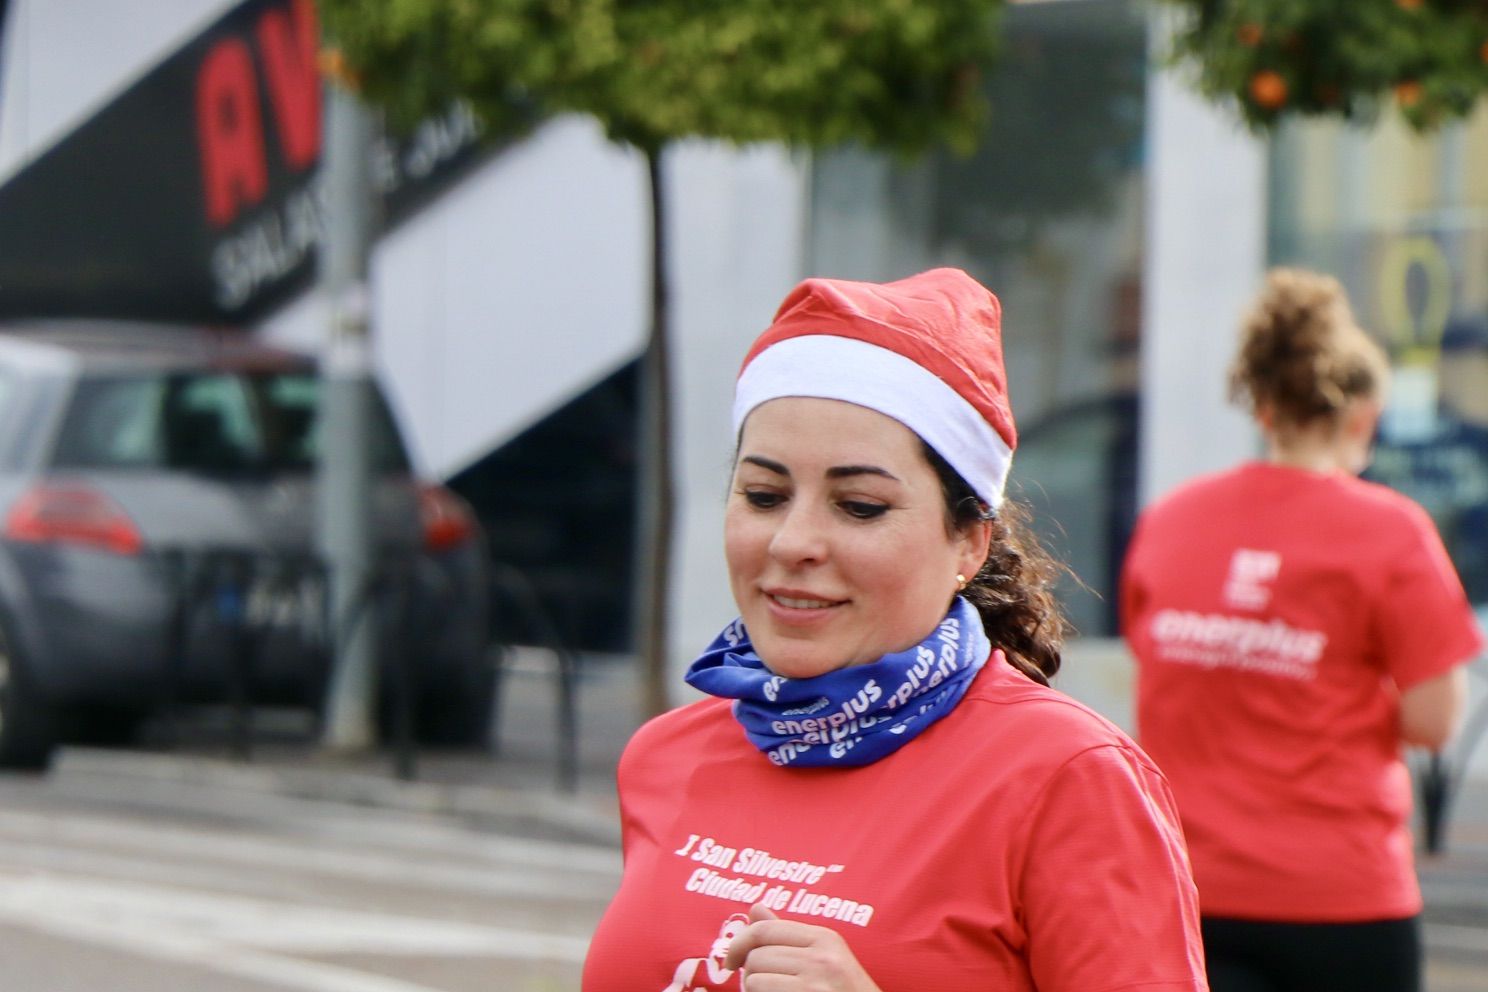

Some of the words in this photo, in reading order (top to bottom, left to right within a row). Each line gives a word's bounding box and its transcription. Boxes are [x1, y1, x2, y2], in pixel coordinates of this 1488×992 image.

[771, 679, 883, 736] enerplus
[674, 834, 699, 856] I
[691, 838, 737, 869] San
[732, 848, 827, 885] Silvestre
[685, 867, 768, 904] Ciudad
[761, 885, 792, 911] de
[787, 888, 874, 928] Lucena
